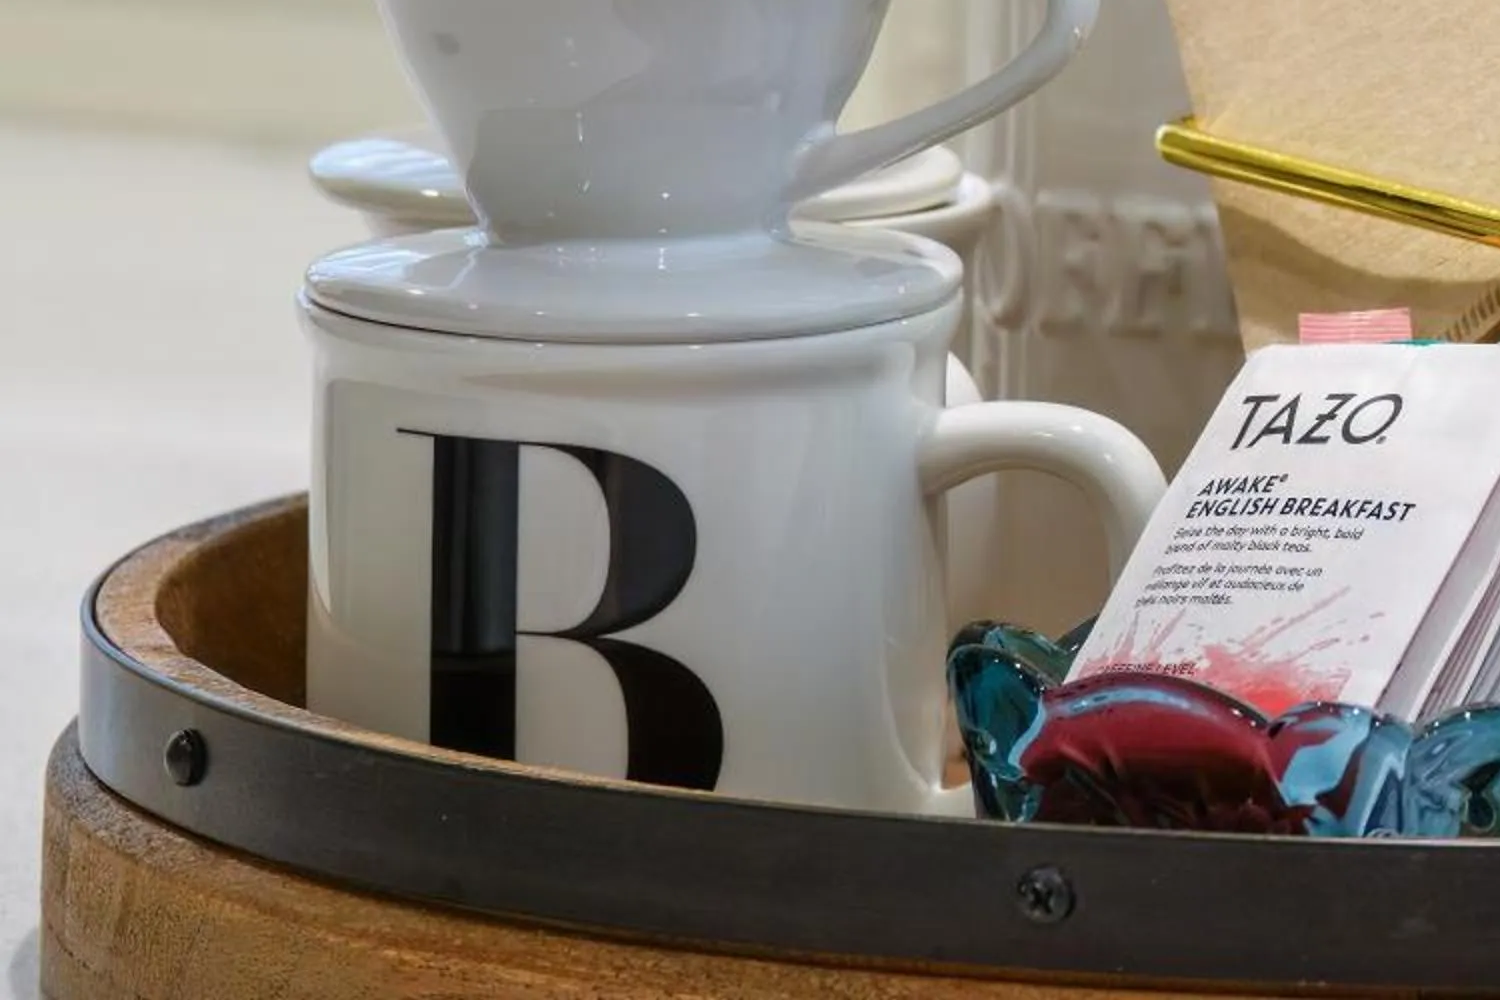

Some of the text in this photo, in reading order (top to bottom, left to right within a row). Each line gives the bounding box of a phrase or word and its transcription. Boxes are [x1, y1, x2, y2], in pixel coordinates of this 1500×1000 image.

[1185, 497, 1417, 522] ENGLISH BREAKFAST
[1205, 524, 1225, 537] the
[1226, 524, 1248, 538] day
[1250, 523, 1278, 537] with
[1279, 527, 1289, 537] a
[1333, 528, 1365, 540] bold
[1196, 539, 1213, 552] of
[1247, 540, 1280, 551] black
[1197, 562, 1213, 574] de
[1274, 566, 1304, 577] avec
[1305, 567, 1323, 577] un
[1208, 579, 1224, 589] et
[1287, 580, 1305, 591] de
